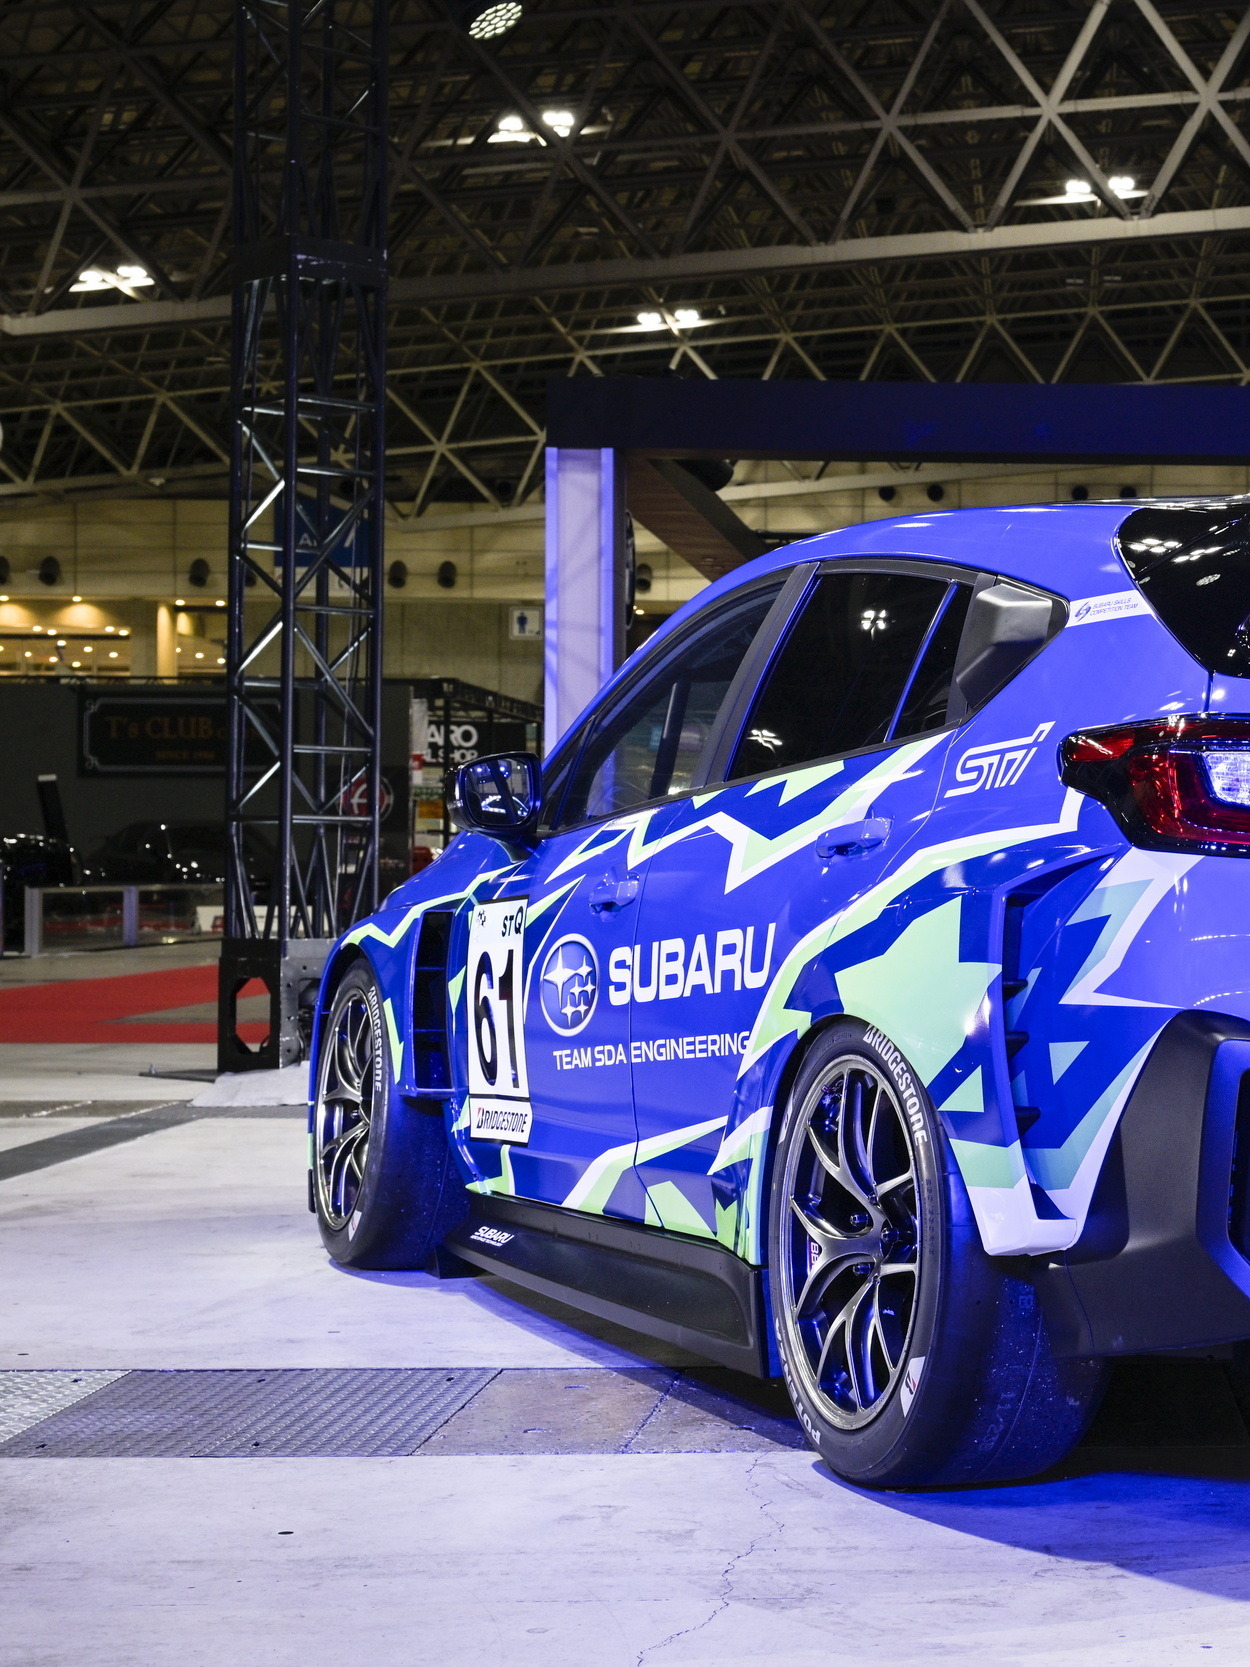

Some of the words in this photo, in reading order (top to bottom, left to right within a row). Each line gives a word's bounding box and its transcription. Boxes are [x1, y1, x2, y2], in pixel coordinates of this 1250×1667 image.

[145, 715, 214, 739] CLUB
[608, 922, 777, 1006] SUBARU
[367, 985, 382, 1093] BRIDGESTONE
[473, 949, 520, 1089] 61
[553, 1049, 594, 1070] TEAM
[594, 1044, 627, 1067] SDA
[631, 1030, 751, 1064] ENGINEERING
[862, 1022, 928, 1146] BRIDGESTONE
[476, 1107, 528, 1133] BRIDGESTONE
[474, 1225, 515, 1245] SUBARU
